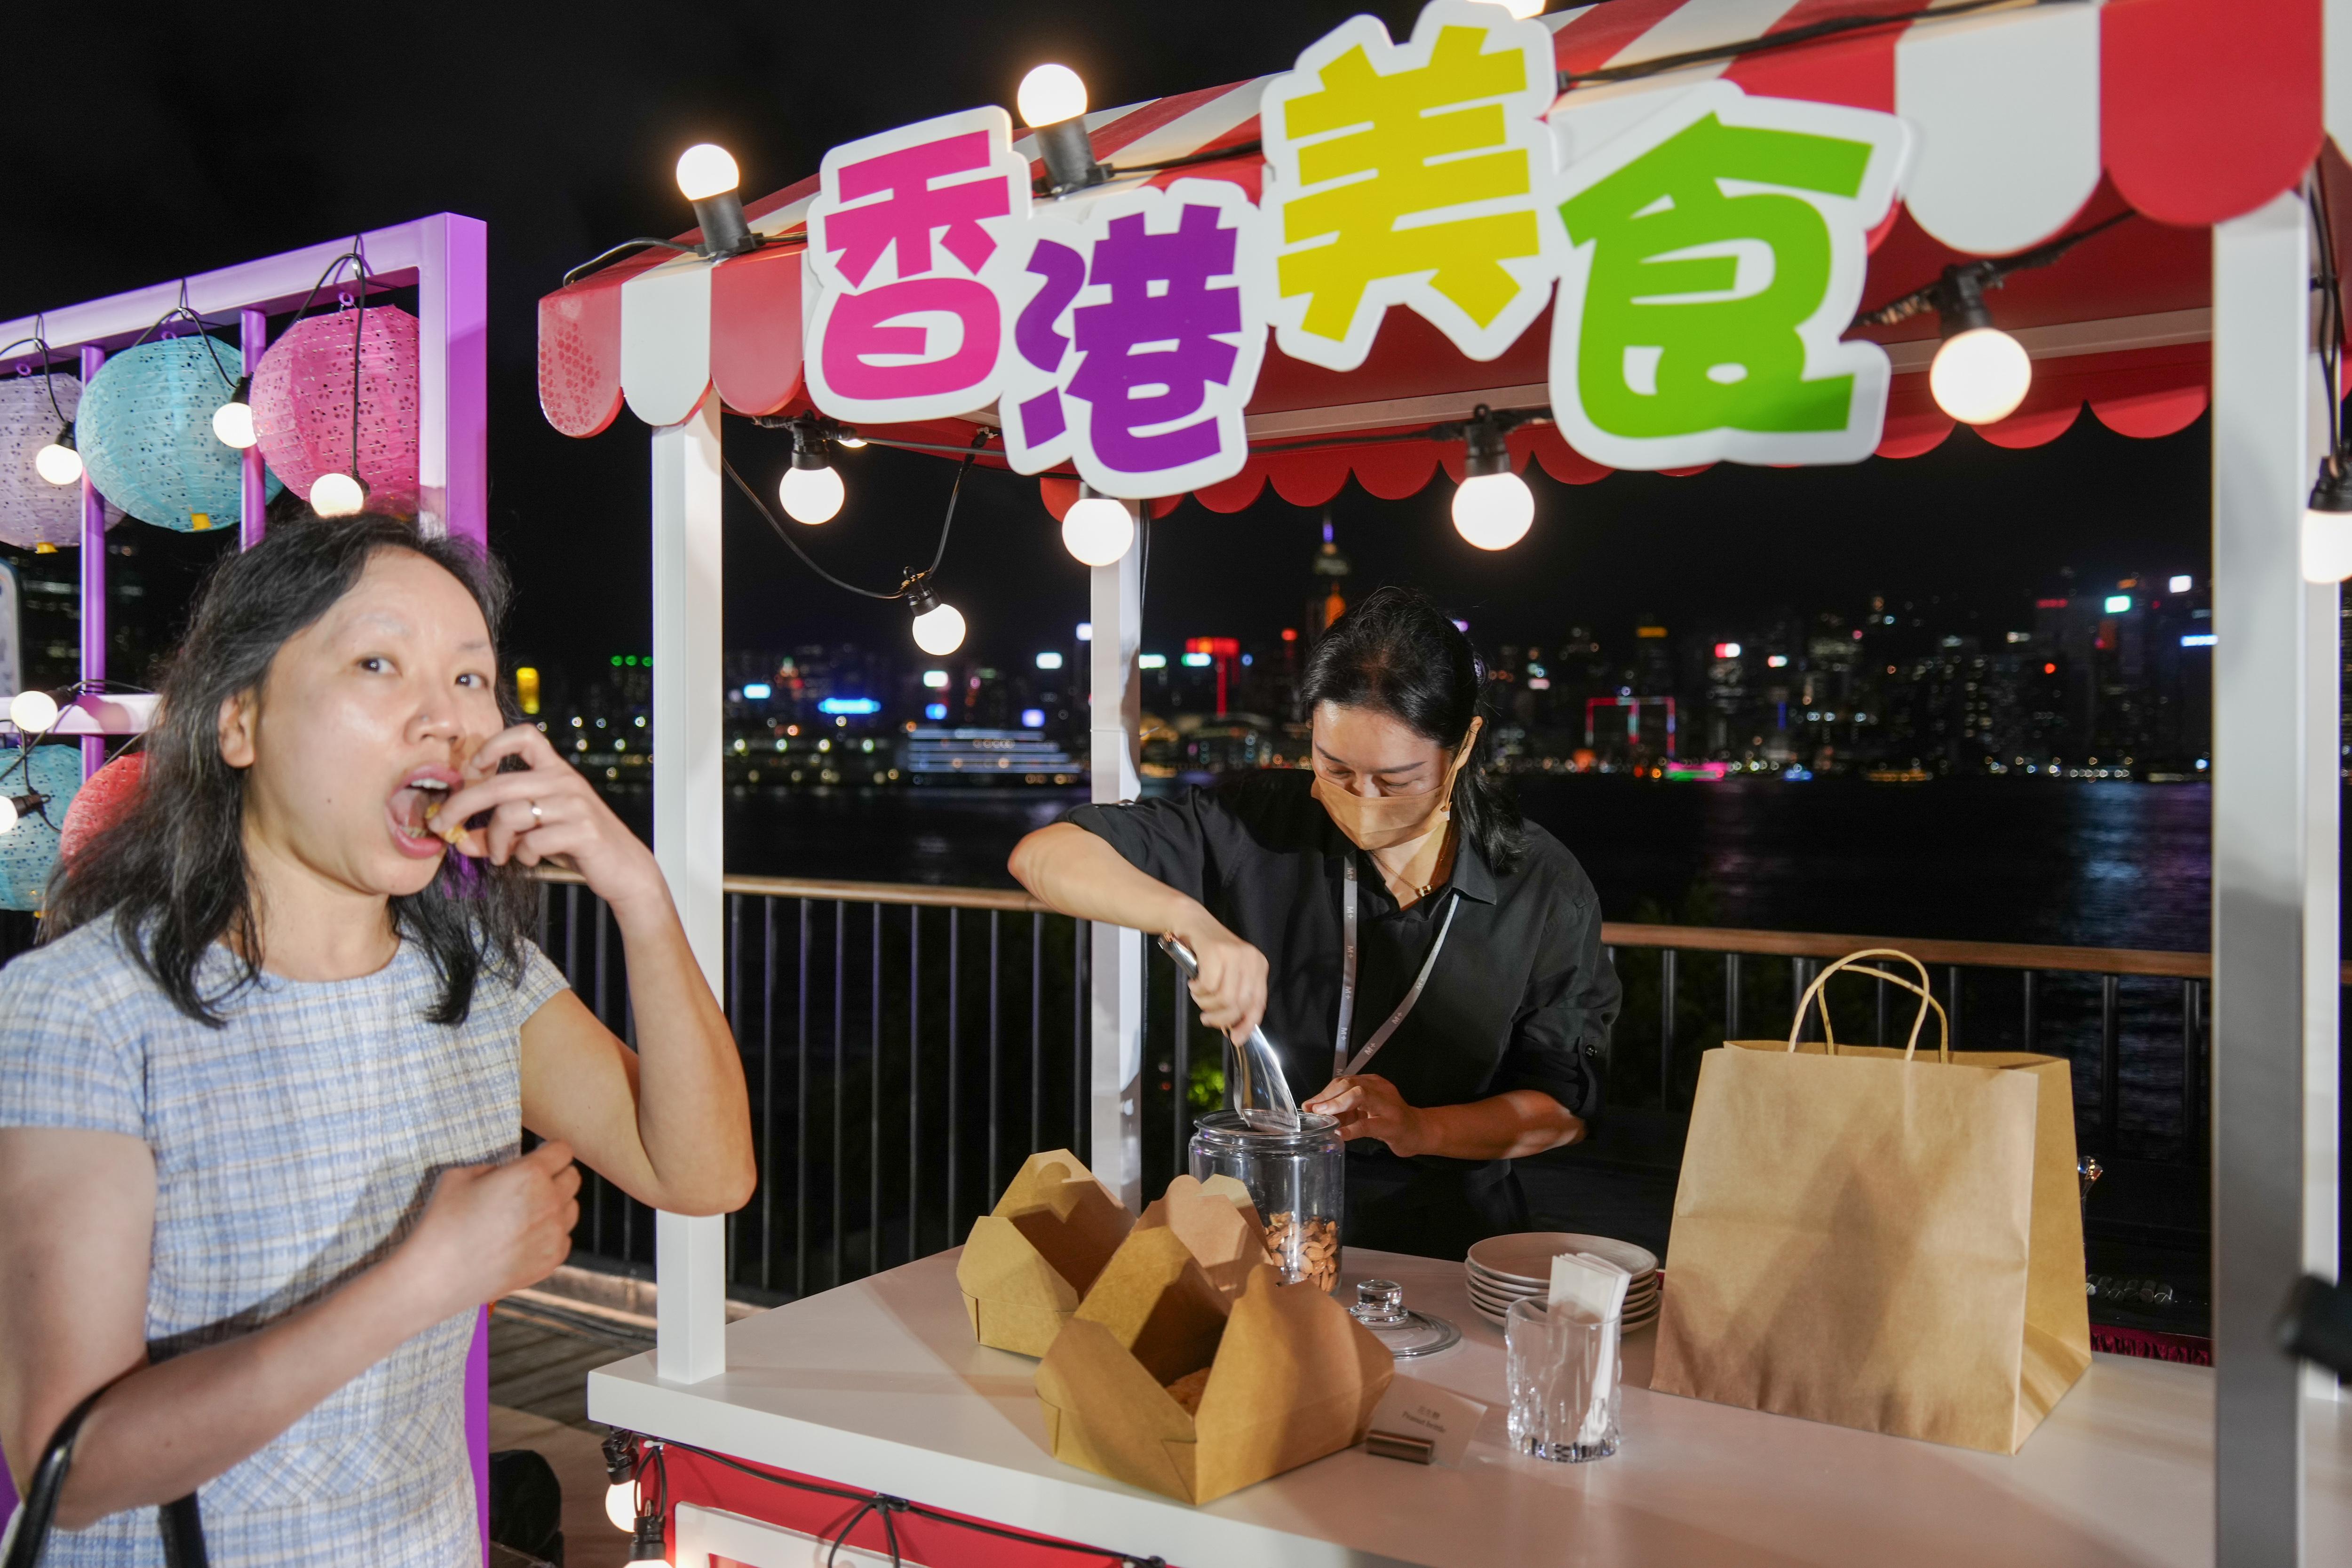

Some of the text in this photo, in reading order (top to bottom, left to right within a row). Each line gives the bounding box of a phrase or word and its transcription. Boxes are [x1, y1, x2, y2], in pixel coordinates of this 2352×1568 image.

[822, 25, 1874, 472] 香港美食
[1347, 868, 1353, 880] M+
[1347, 906, 1353, 919] M+
[1347, 946, 1353, 958] M+
[1416, 977, 1424, 990] M+
[1345, 986, 1351, 1000] M+
[1391, 1012, 1402, 1024] M+
[1341, 1027, 1348, 1041] M+
[1364, 1043, 1375, 1055] M+
